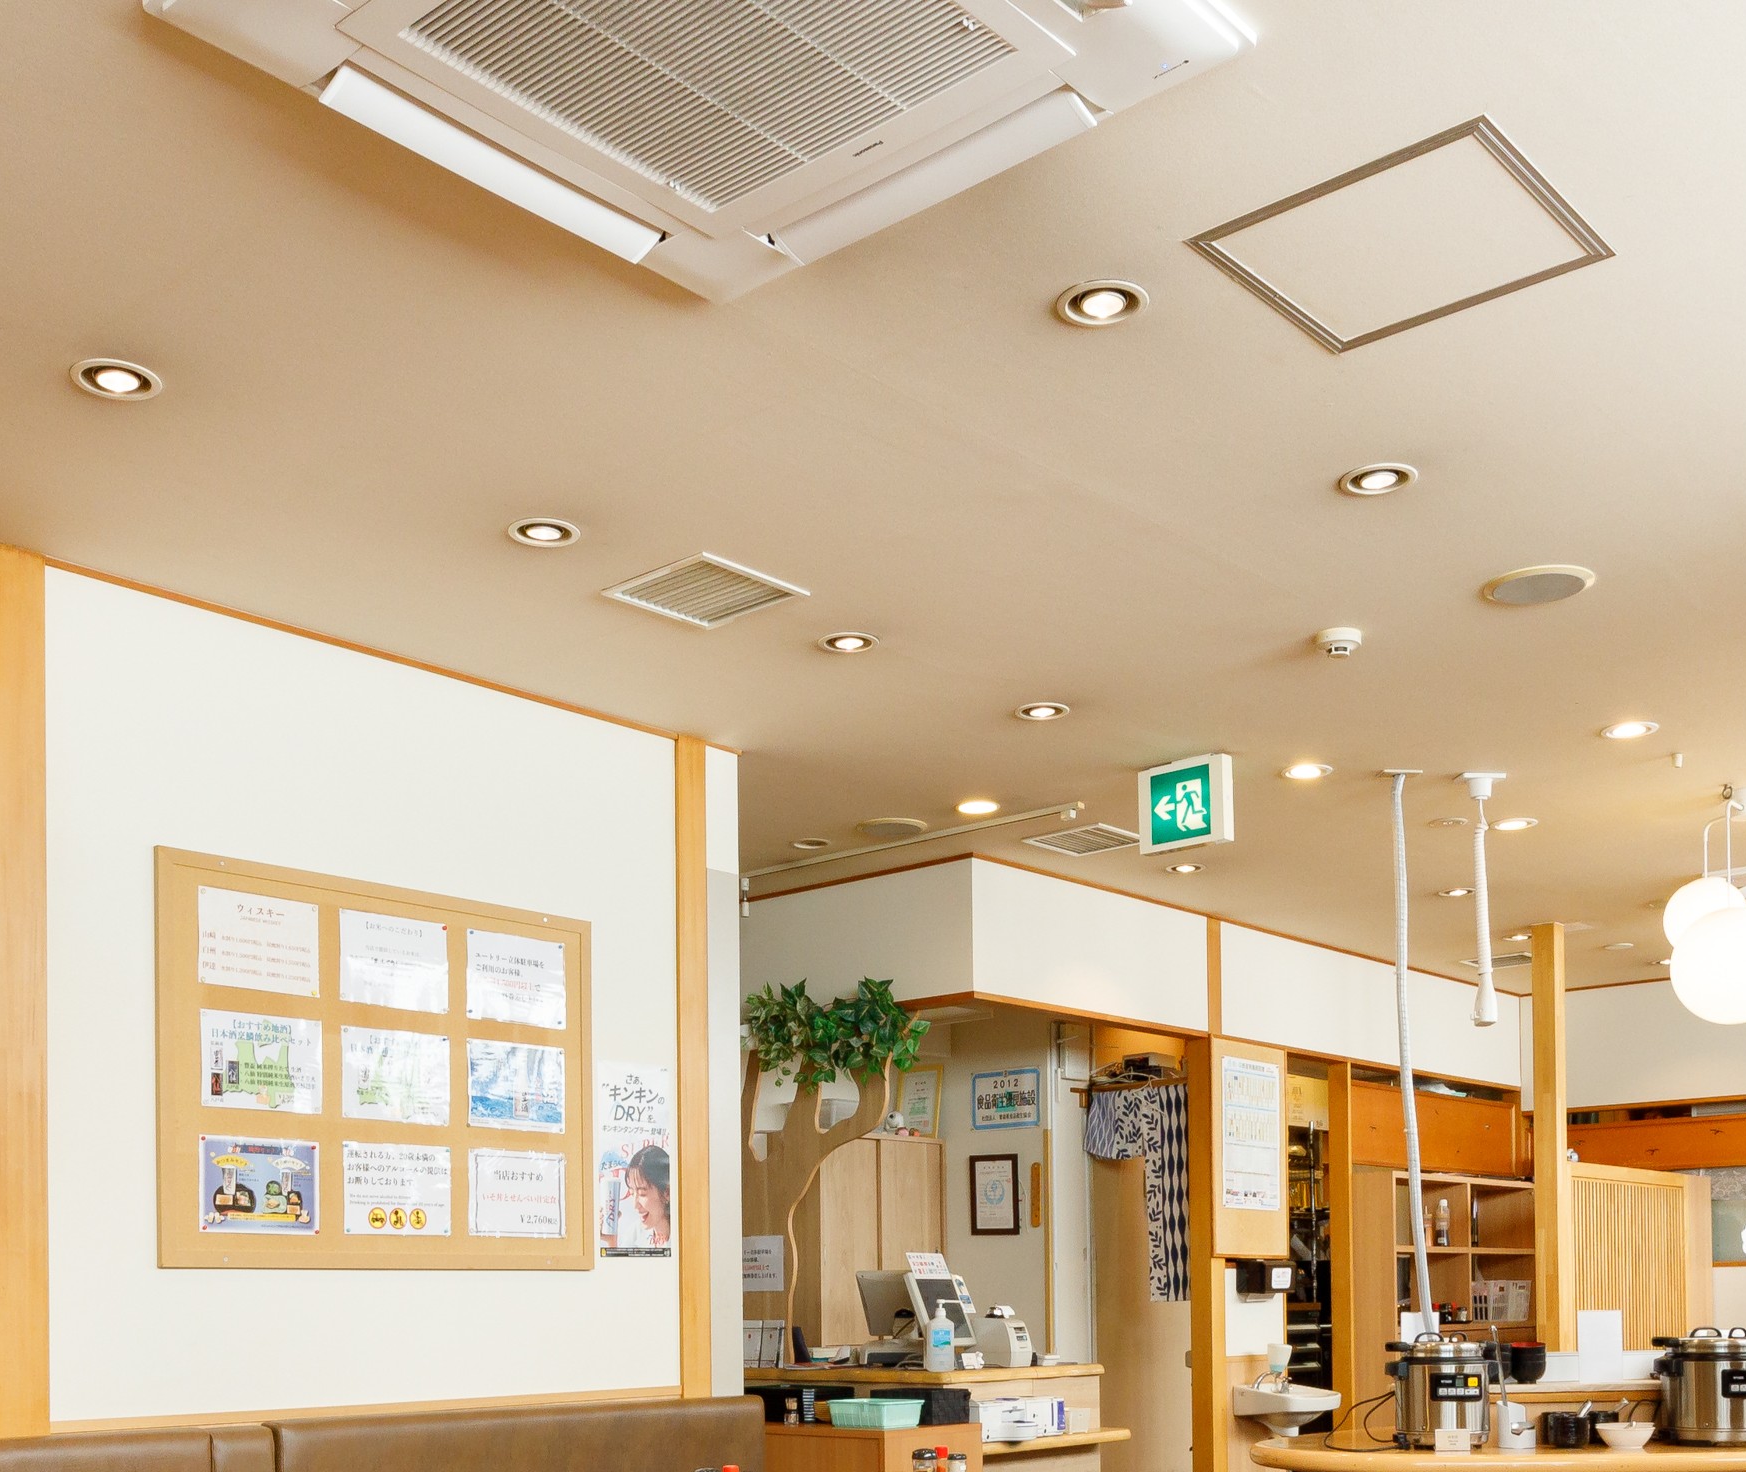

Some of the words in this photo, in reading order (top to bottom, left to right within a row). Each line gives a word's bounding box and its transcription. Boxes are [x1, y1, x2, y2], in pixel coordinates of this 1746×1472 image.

[237, 903, 285, 918] ウィスキー
[993, 1078, 1019, 1089] 2012
[494, 1169, 543, 1182] 当店おすすめ
